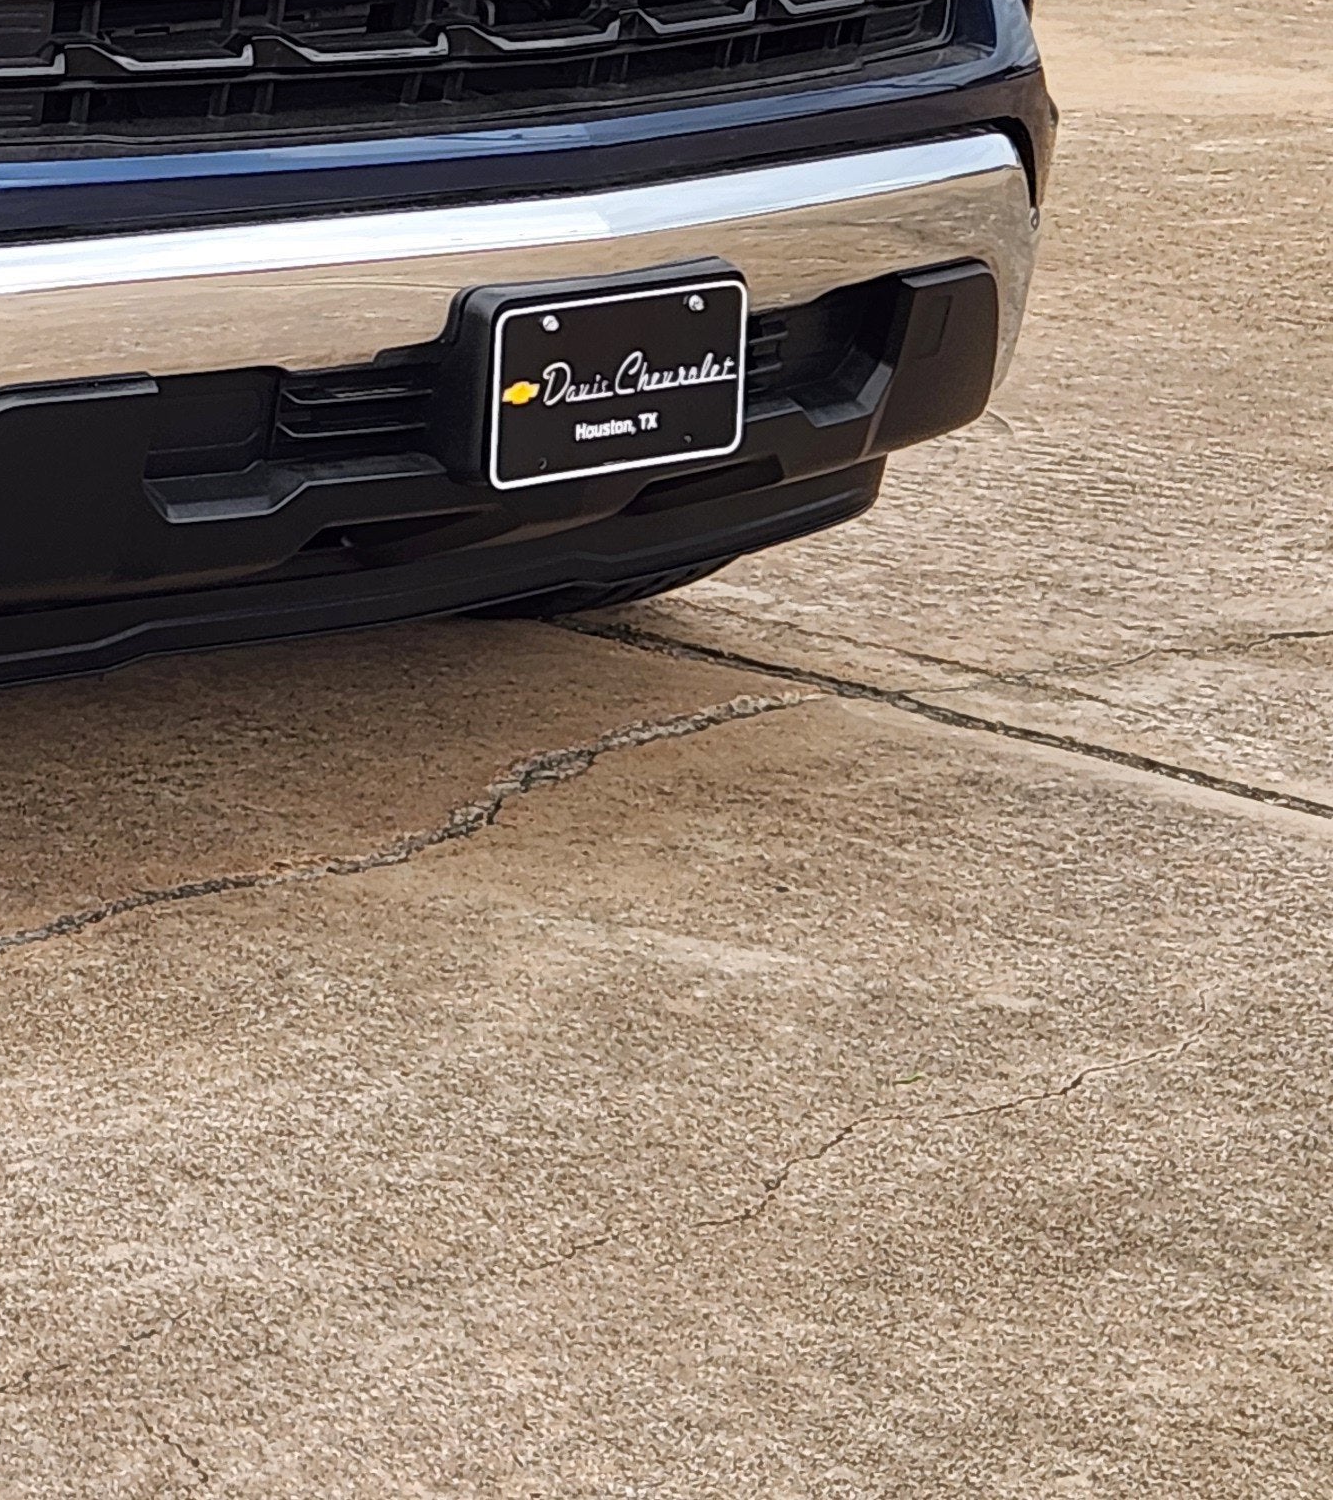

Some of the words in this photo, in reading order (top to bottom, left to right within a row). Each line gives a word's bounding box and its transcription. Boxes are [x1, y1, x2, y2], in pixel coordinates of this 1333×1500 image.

[542, 361, 614, 406] Davis
[614, 350, 738, 396] Chevrolet
[574, 415, 637, 442] Houston,
[637, 411, 659, 431] TX
